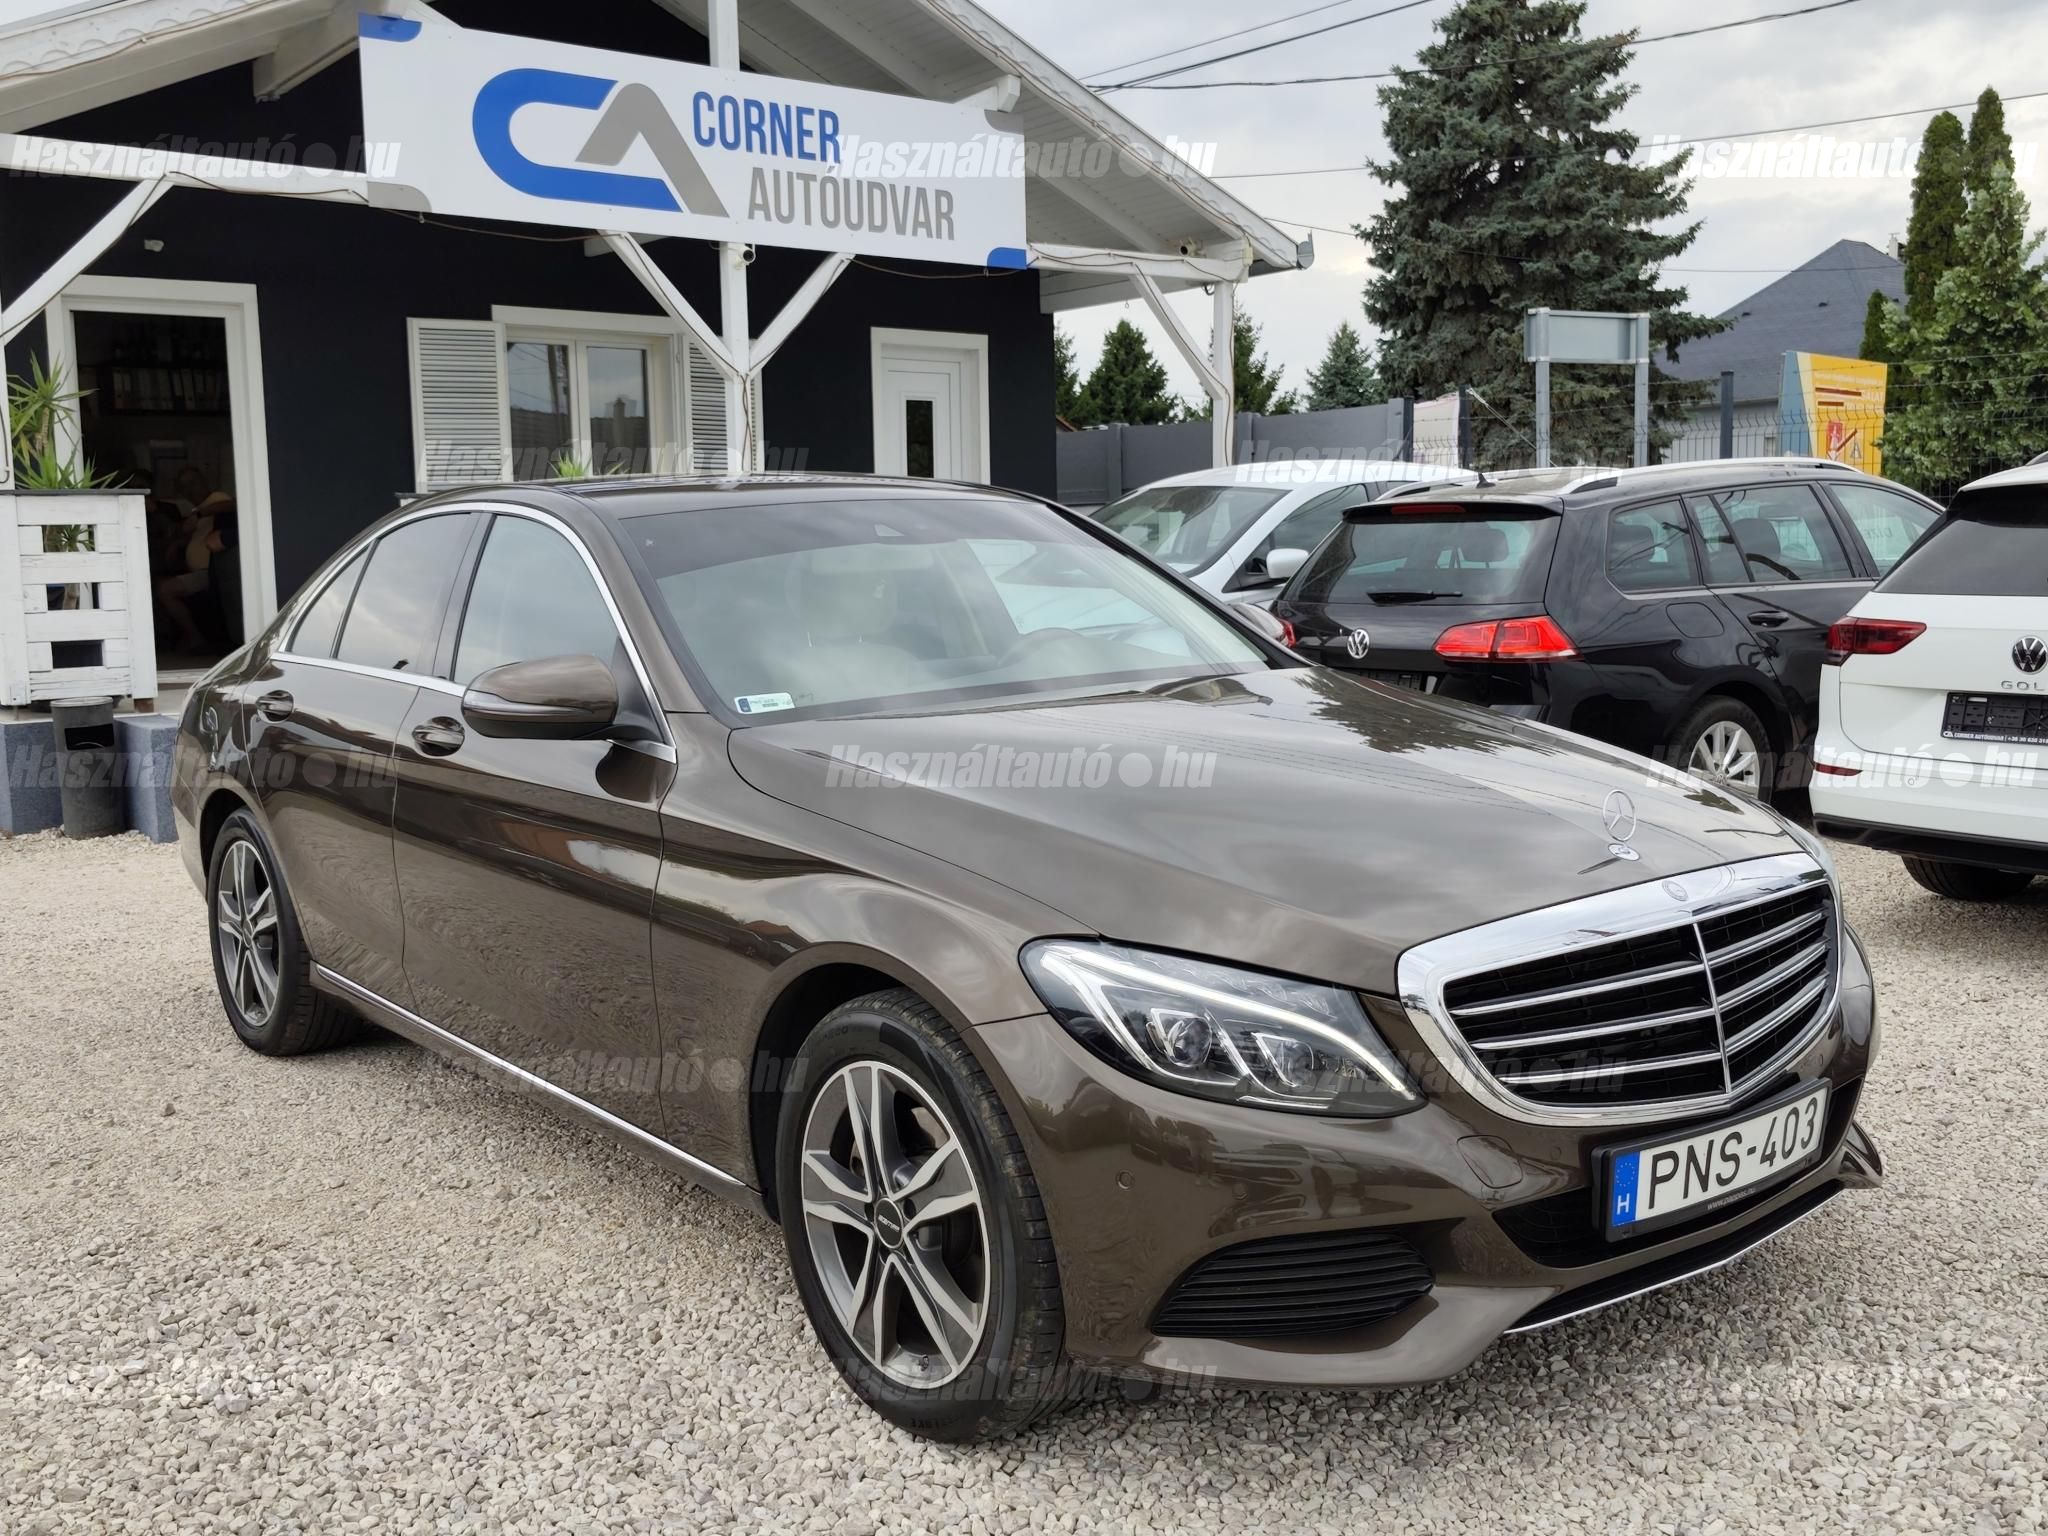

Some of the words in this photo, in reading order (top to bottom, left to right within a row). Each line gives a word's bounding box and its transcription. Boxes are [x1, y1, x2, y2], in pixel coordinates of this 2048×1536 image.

[693, 91, 841, 164] CORNER
[748, 161, 954, 240] AUTÓUDVAR
[2001, 681, 2045, 691] GOL
[1648, 1097, 1818, 1210] PNS-403
[1617, 1193, 1630, 1215] H
